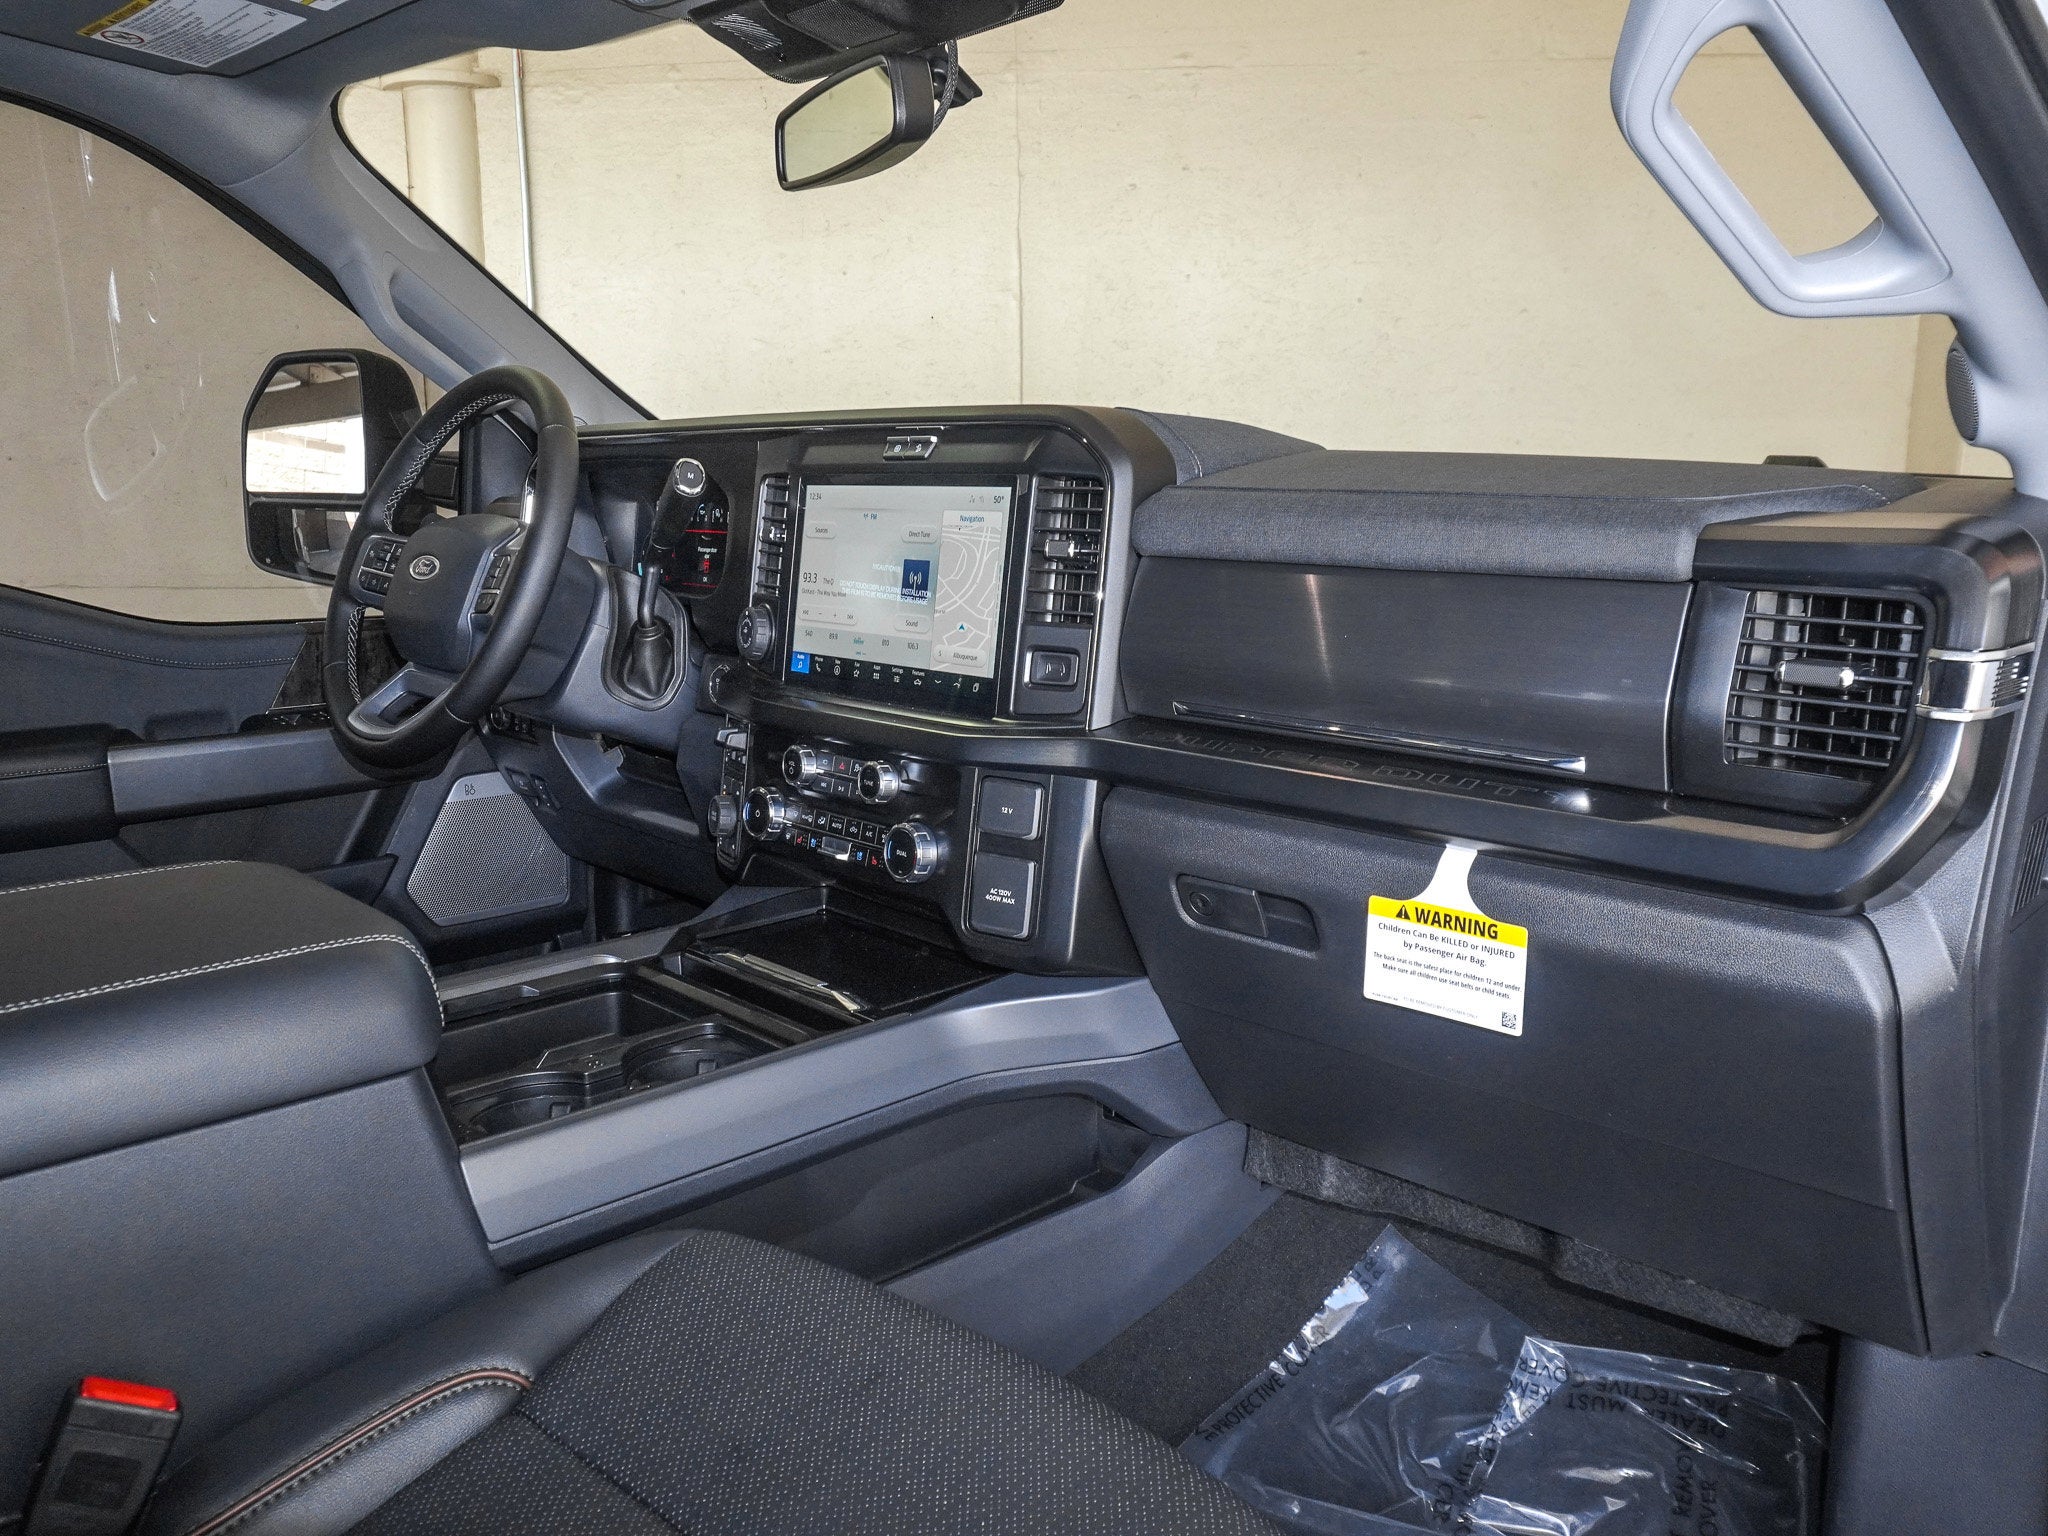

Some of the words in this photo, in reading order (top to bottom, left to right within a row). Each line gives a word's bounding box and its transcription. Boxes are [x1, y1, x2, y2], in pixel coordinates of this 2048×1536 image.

[687, 472, 695, 480] M
[959, 514, 985, 523] Navigation
[802, 572, 818, 584] 93.3
[902, 588, 932, 598] INSTALLATION
[905, 619, 919, 628] Sound
[953, 652, 978, 661] Albuquerque
[863, 779, 874, 787] TUNE
[1001, 806, 1009, 814] 12
[831, 822, 842, 830] AUTO
[865, 830, 873, 838] A/C
[896, 849, 908, 858] DUAL
[989, 887, 998, 895] AC
[998, 889, 1012, 897] 120V
[985, 893, 1002, 903] 400W
[1002, 896, 1015, 905] MAX
[1414, 906, 1499, 941] WARNING
[1378, 922, 1411, 936] Children
[1412, 929, 1428, 939] Can
[1429, 933, 1440, 942] Be
[1441, 936, 1469, 949] KILLED
[1470, 943, 1480, 951] or
[1481, 945, 1516, 959] INJURED
[1403, 940, 1413, 950] by
[1414, 942, 1454, 959] Passenger
[1456, 952, 1468, 961] Air
[1470, 955, 1487, 968] Bag.
[1384, 953, 1396, 961] back
[1397, 956, 1408, 964] seat
[1423, 962, 1439, 971] safest
[1439, 967, 1453, 975] place
[1463, 972, 1485, 983] children
[1486, 977, 1492, 985] 12
[1493, 980, 1504, 988] and
[1382, 962, 1397, 971] Make
[1416, 971, 1438, 981] children
[1438, 976, 1448, 984] use
[1448, 978, 1460, 987] seat
[1460, 981, 1474, 991] belts
[1481, 987, 1495, 996] child
[1209, 1374, 1286, 1437] PROTECTIVE
[1566, 1391, 1625, 1414] MUST
